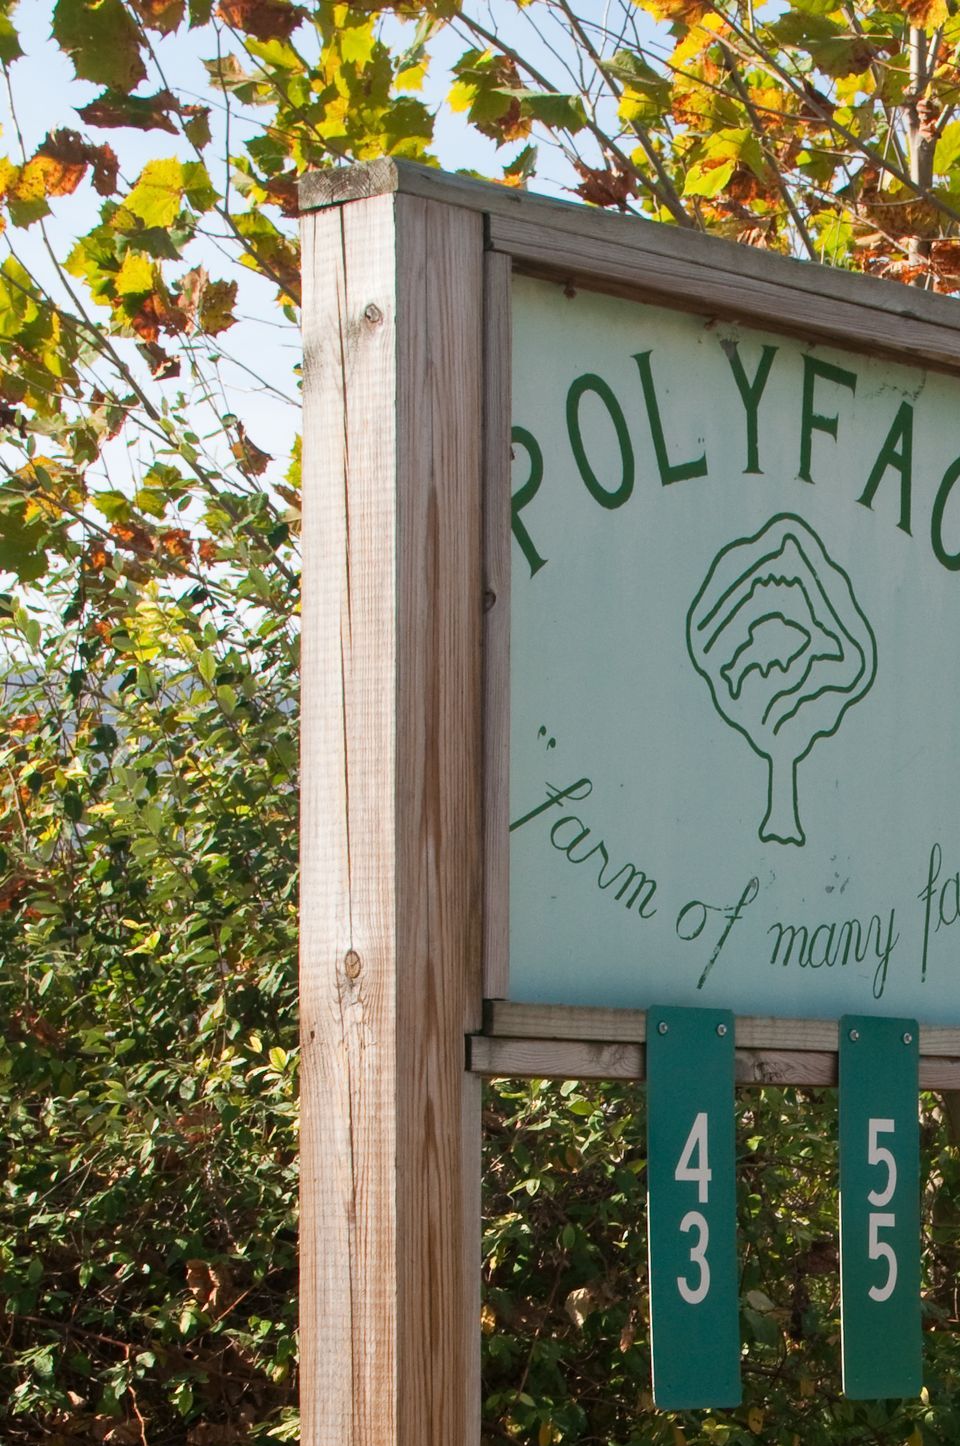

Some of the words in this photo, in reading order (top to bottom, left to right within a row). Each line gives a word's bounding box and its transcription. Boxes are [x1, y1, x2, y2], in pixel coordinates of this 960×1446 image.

[676, 877, 760, 989] of
[767, 908, 900, 999] many
[674, 1112, 712, 1305] 43
[867, 1118, 898, 1302] 55
